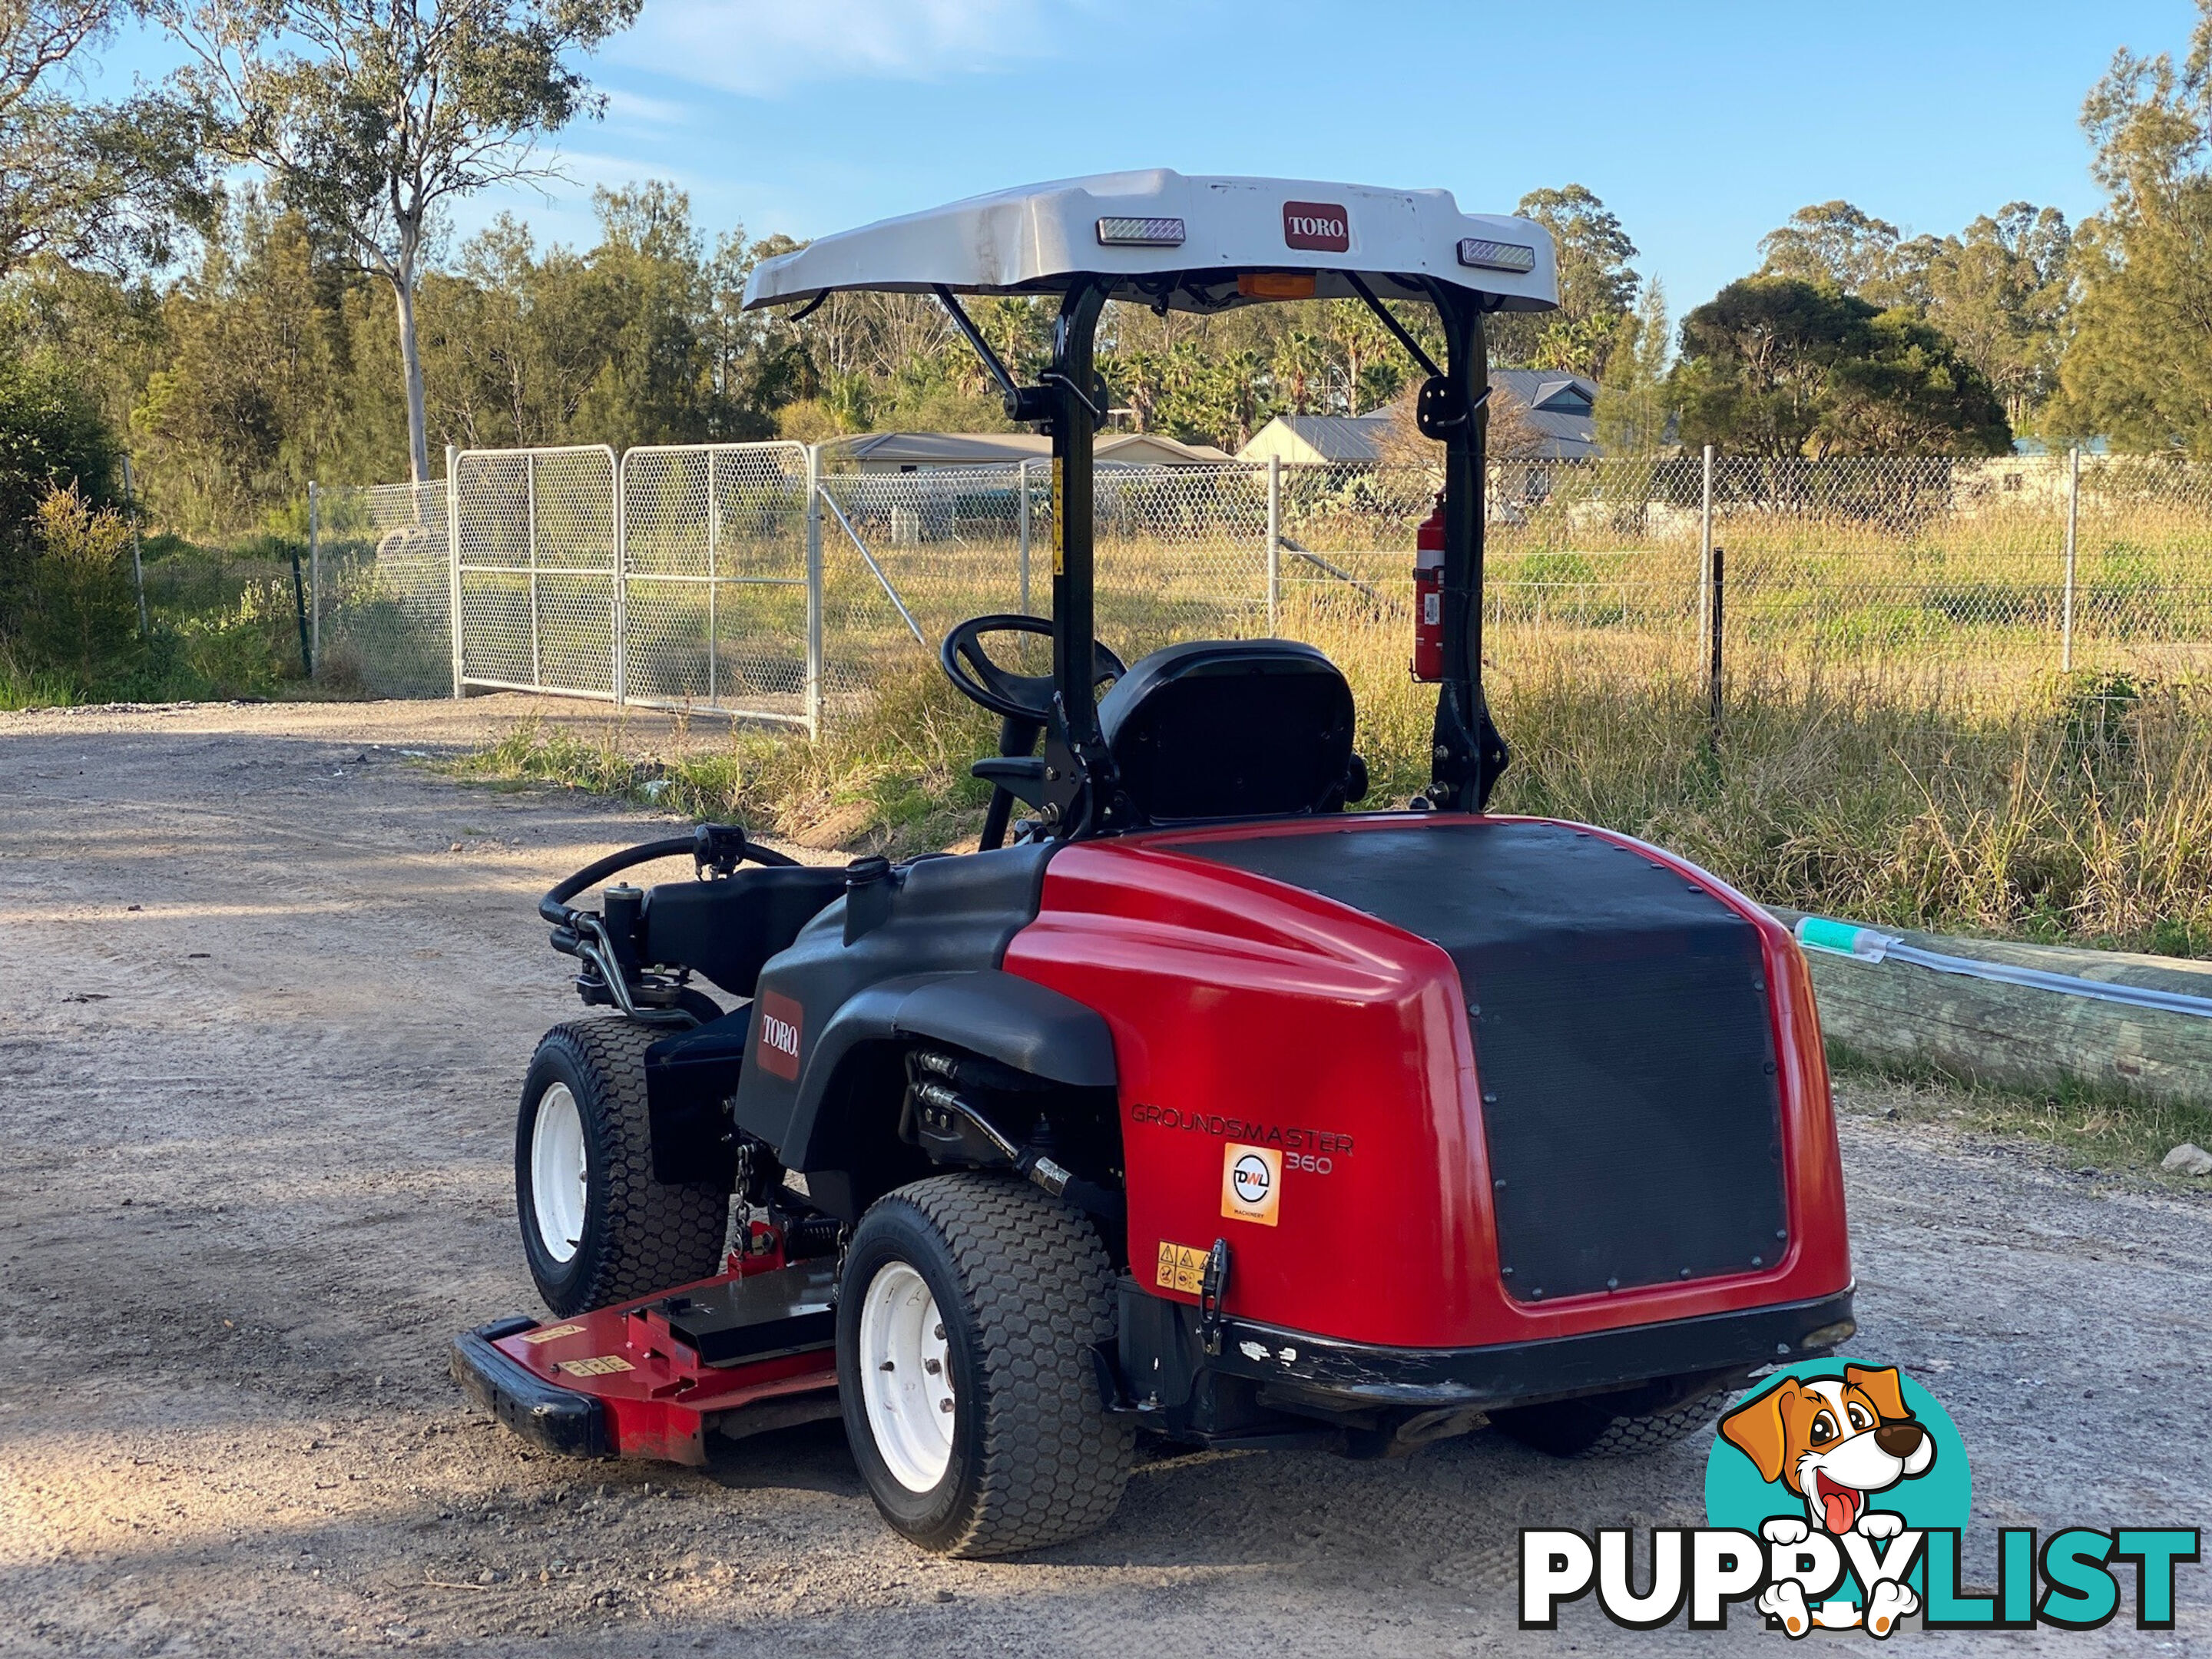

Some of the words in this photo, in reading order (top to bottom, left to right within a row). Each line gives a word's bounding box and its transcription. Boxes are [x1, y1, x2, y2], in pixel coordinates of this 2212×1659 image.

[1288, 217, 1344, 237] TORO
[763, 1013, 798, 1055] TORO
[1131, 1103, 1355, 1157] GROUNDSMASTER
[1285, 1151, 1333, 1175] 360
[1234, 1169, 1270, 1187] DWL
[1233, 1208, 1265, 1219] MACHINERY
